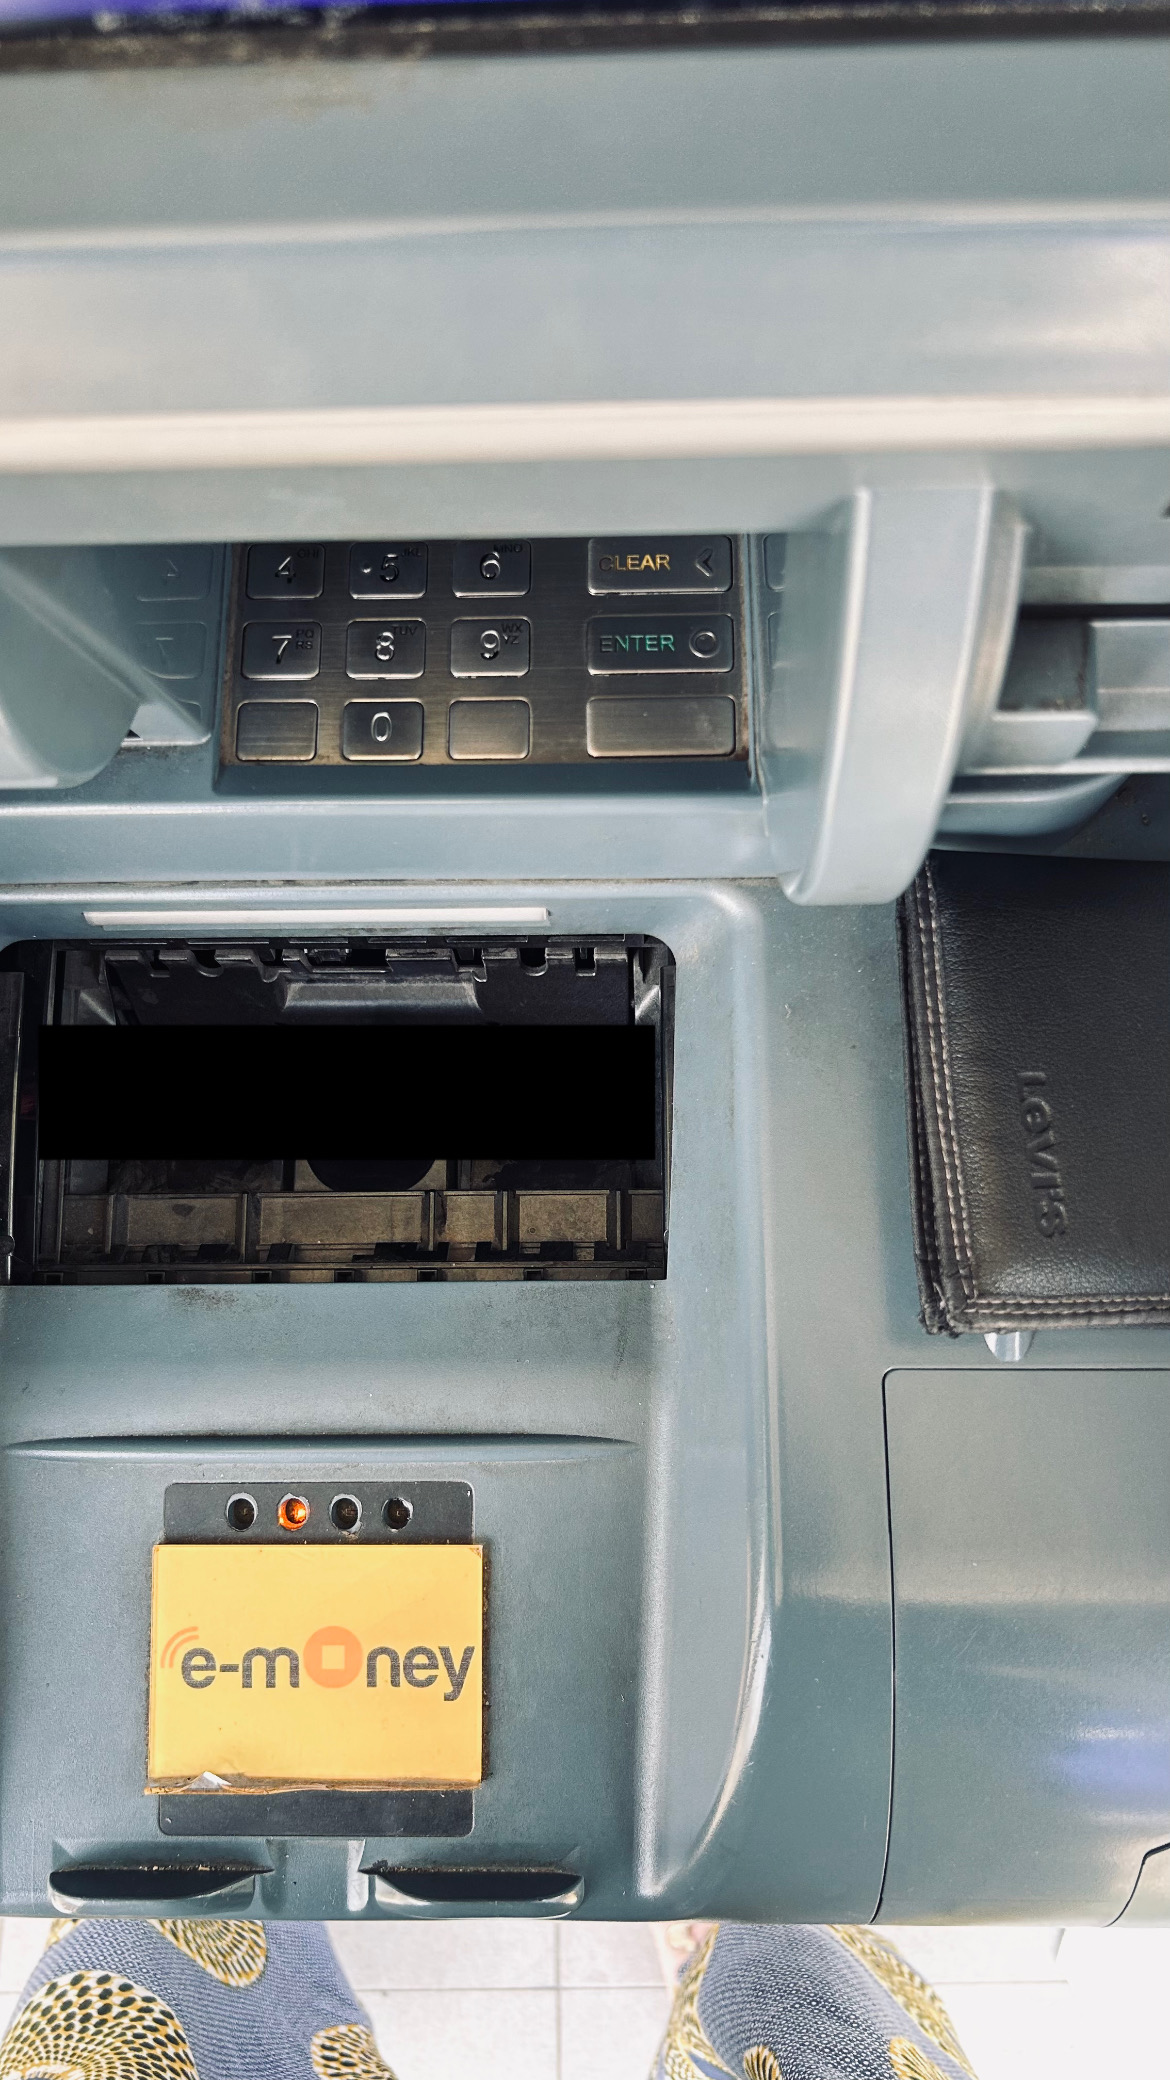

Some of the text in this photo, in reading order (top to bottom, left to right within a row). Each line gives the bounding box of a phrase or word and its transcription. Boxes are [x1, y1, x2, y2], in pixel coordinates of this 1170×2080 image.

[297, 548, 319, 559] GHI
[494, 544, 523, 554] MNO
[275, 555, 296, 584] 4
[379, 552, 400, 583] 5
[480, 551, 500, 580] 6
[598, 554, 671, 573] CLEAR
[295, 629, 315, 640] PQ
[392, 626, 418, 636] TUV
[501, 623, 523, 633] WX
[272, 633, 292, 664] 7
[295, 640, 313, 650] RS
[375, 631, 395, 662] 8
[480, 629, 500, 660] 9
[503, 634, 520, 645] YZ
[599, 634, 675, 654] ENTER
[370, 711, 393, 743] 0
[181, 1626, 475, 1702] e-money
